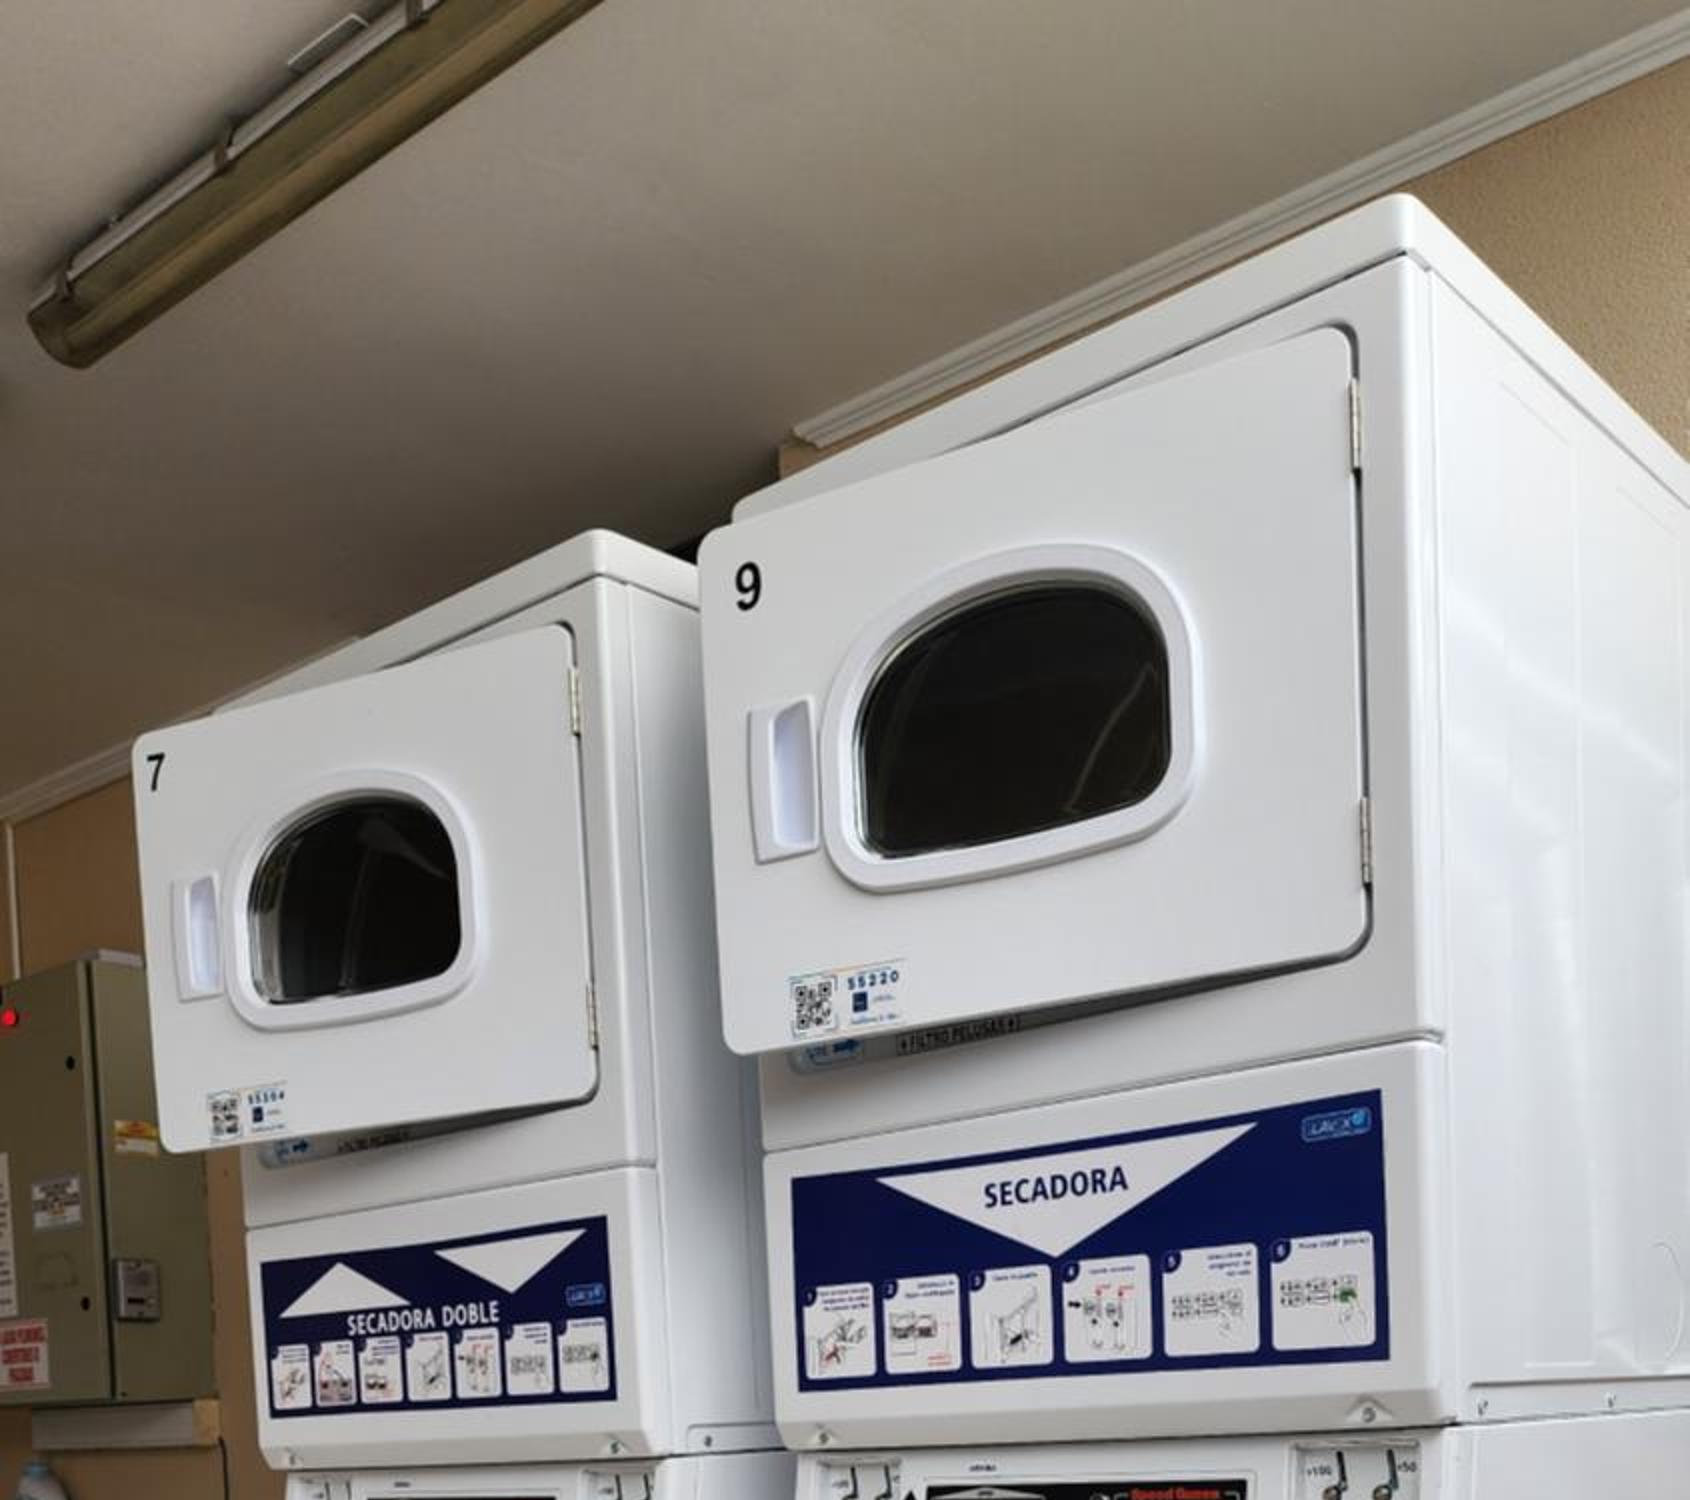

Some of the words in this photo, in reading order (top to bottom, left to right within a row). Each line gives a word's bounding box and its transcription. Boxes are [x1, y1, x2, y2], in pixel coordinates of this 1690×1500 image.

[735, 561, 763, 611] 9
[146, 752, 166, 792] 7
[982, 1165, 1129, 1209] SECADORA
[347, 1305, 437, 1337] SECADORA
[442, 1300, 500, 1327] DOBLE
